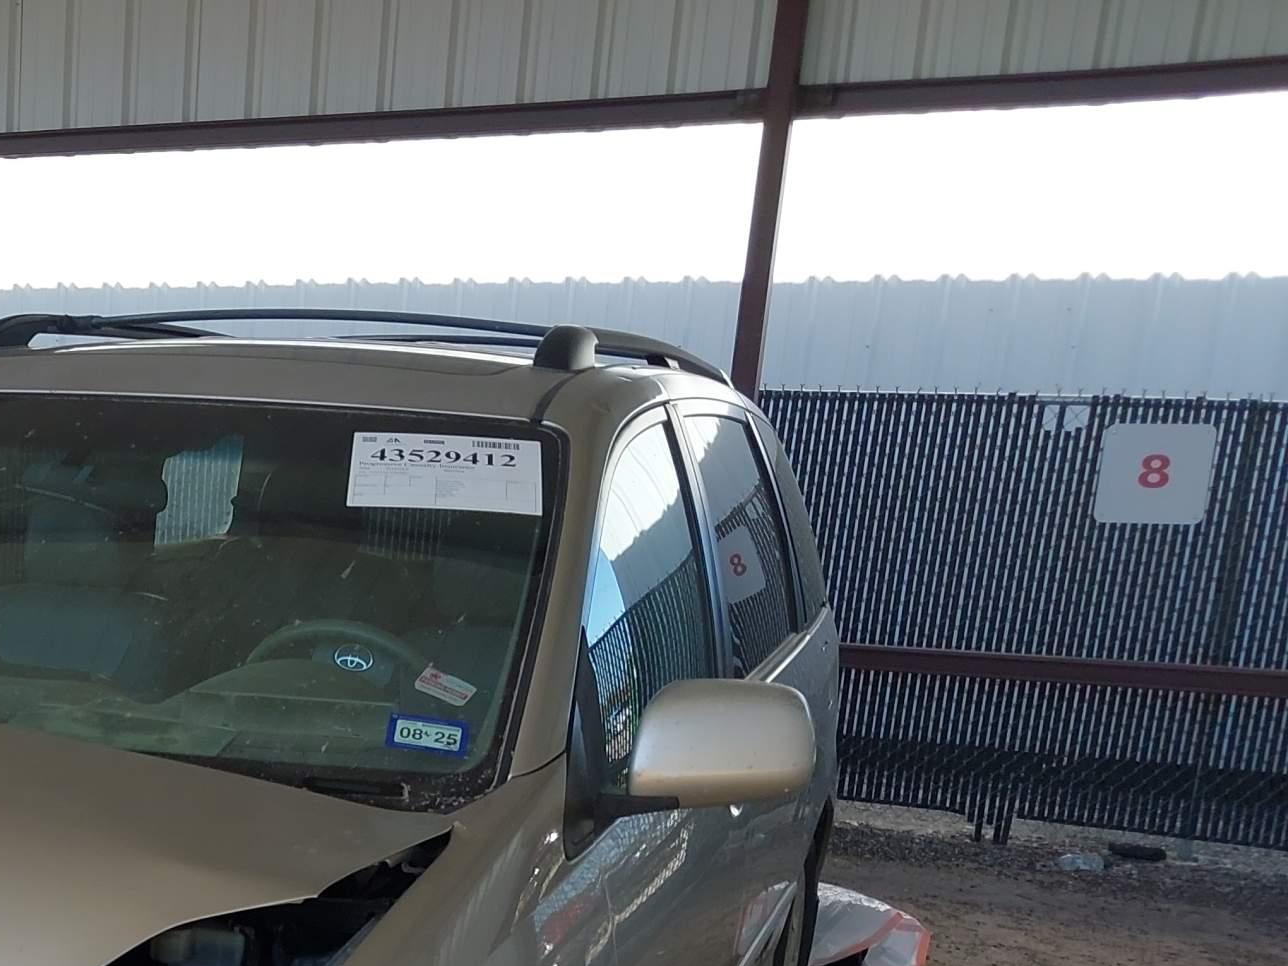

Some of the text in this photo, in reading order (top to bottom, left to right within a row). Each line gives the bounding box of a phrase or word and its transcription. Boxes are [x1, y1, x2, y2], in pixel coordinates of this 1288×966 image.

[370, 447, 517, 468] 43529412
[1137, 453, 1171, 489] 8
[399, 726, 424, 741] 08
[433, 731, 458, 746] 25
